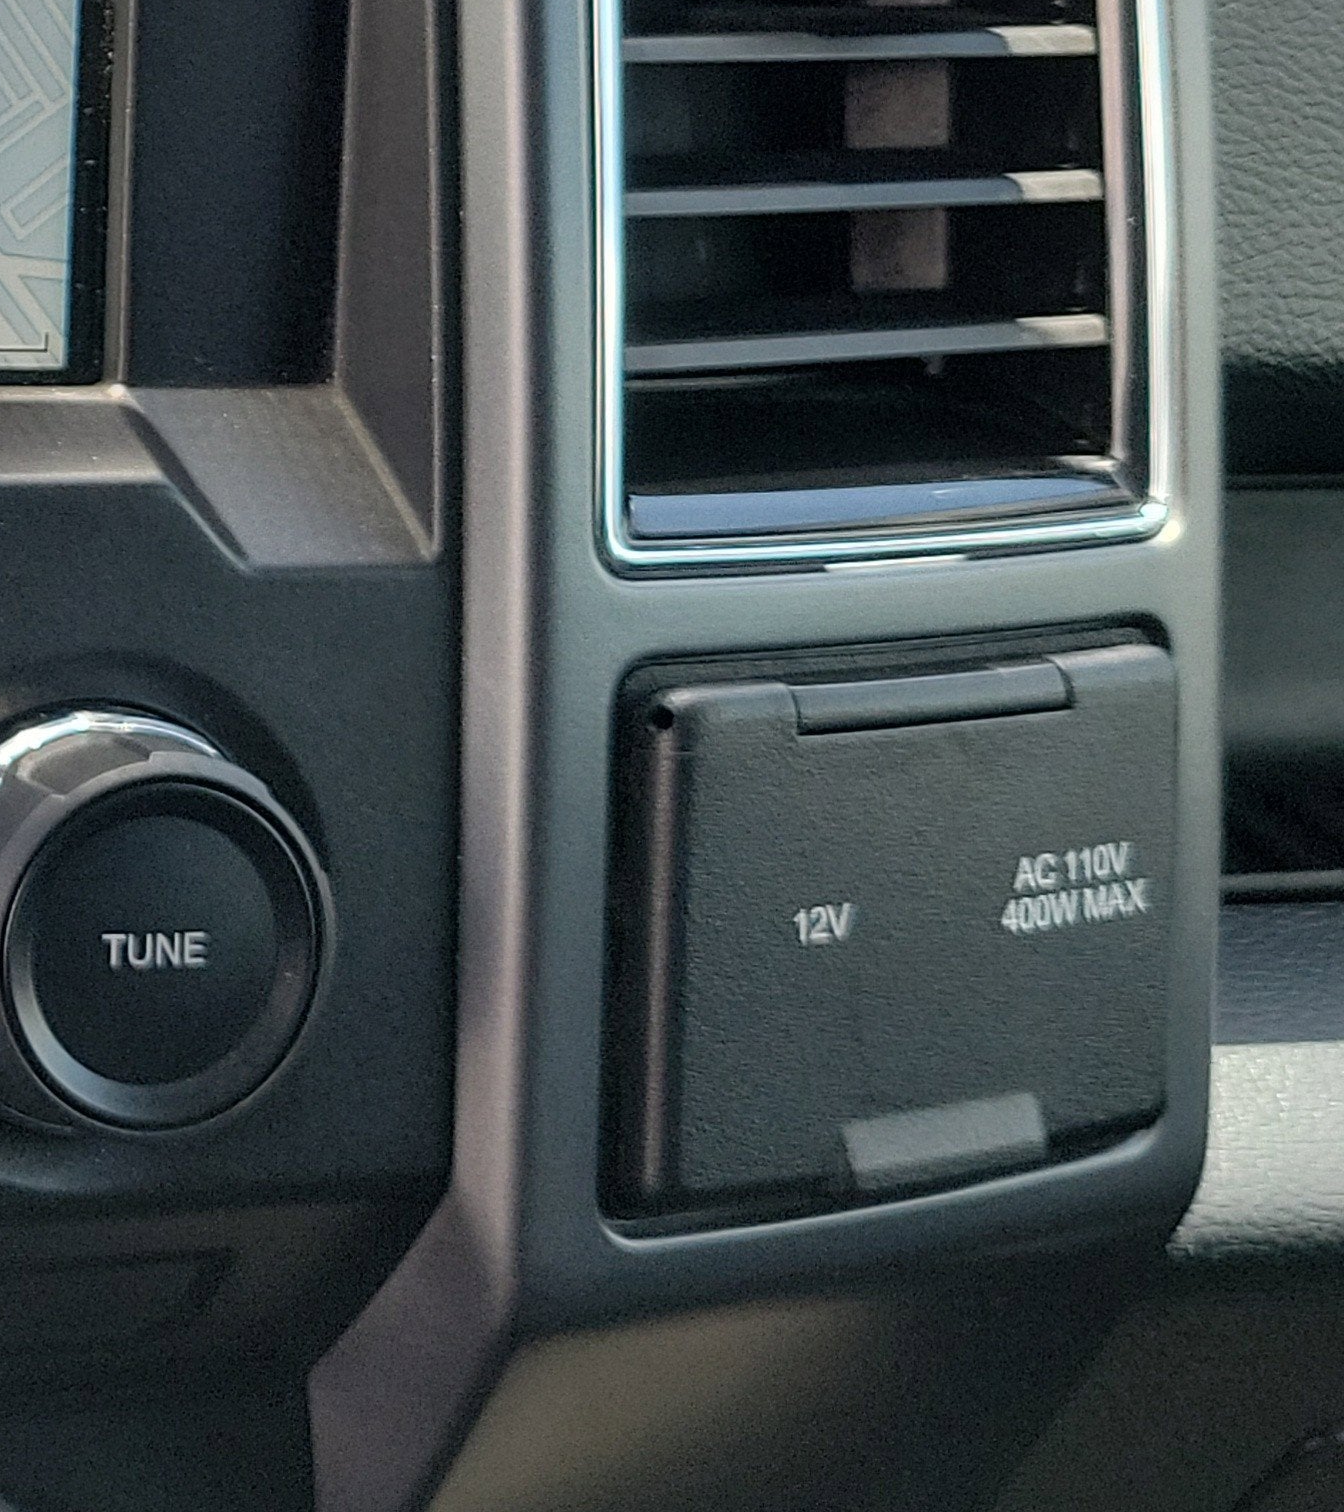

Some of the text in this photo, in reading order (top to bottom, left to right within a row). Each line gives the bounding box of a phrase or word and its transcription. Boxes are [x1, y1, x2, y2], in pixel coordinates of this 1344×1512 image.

[1013, 840, 1132, 892] AC 110V
[793, 903, 852, 945] 12V
[1000, 878, 1149, 935] 400W MAX
[101, 930, 210, 970] TUNE
